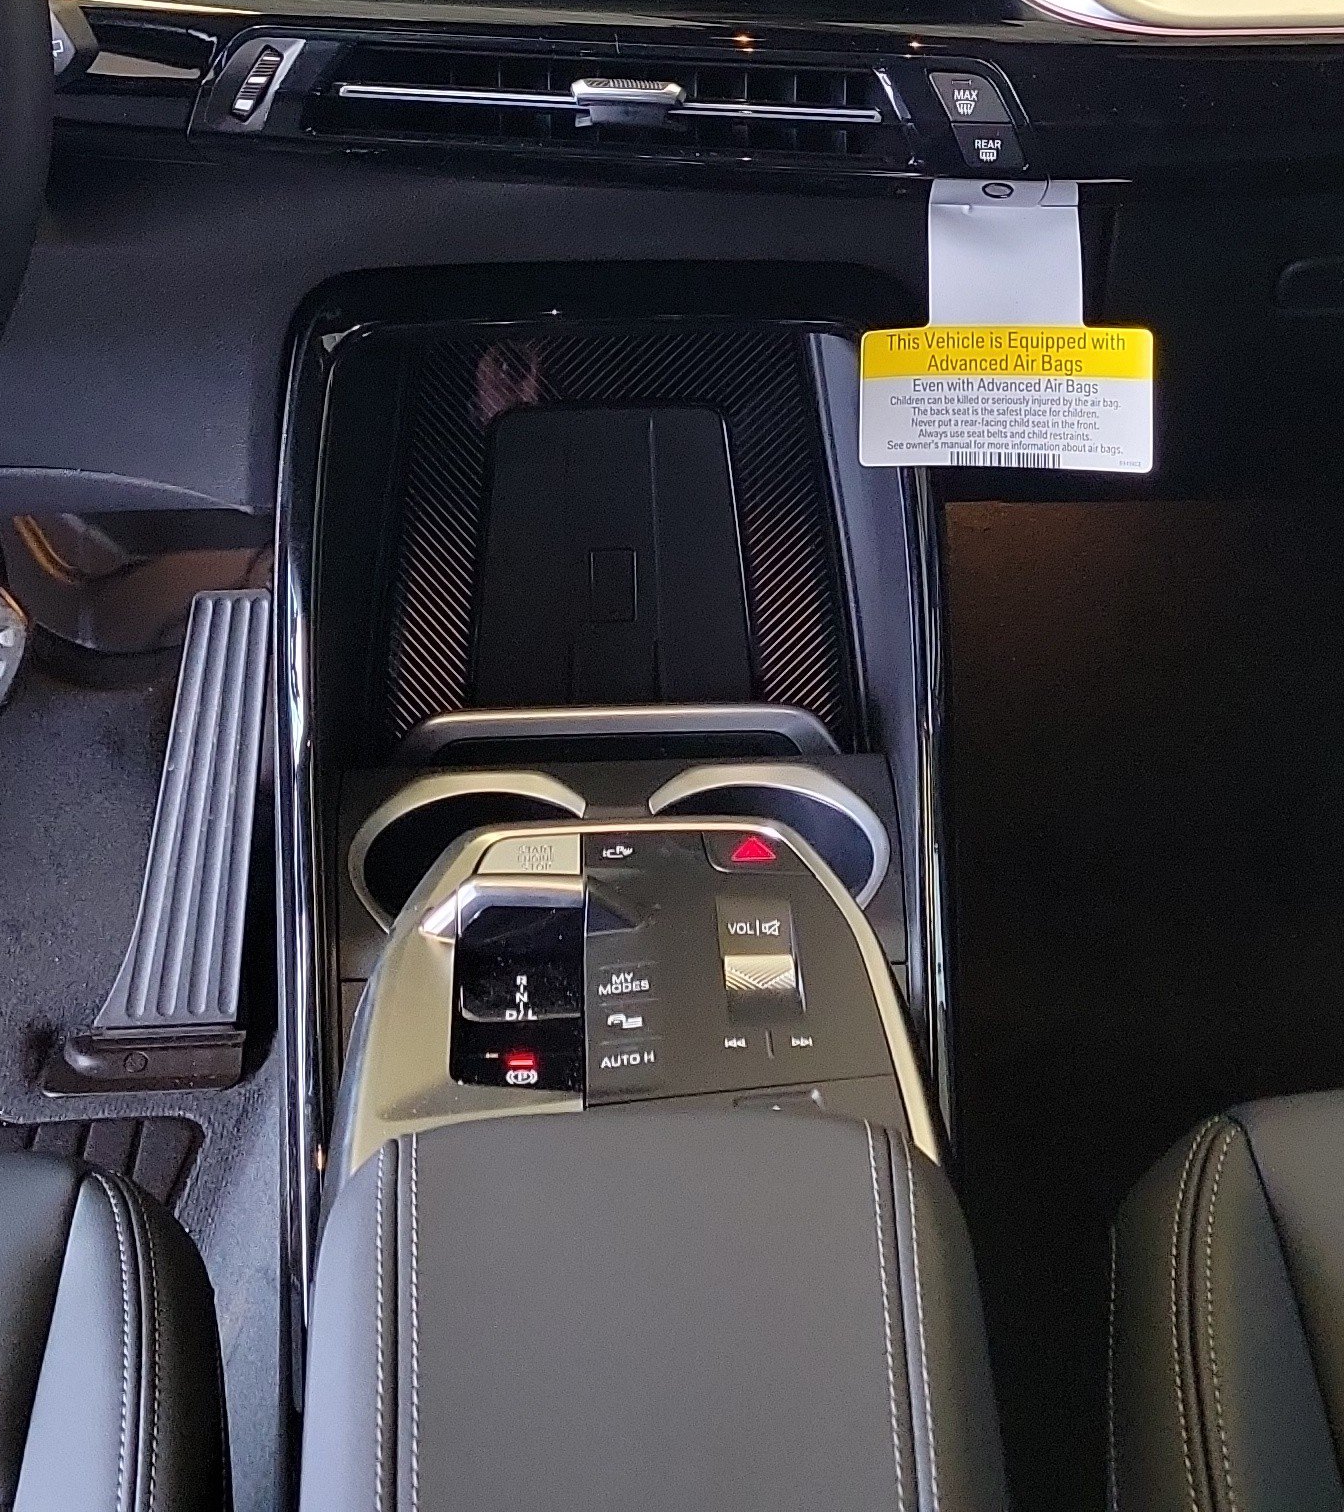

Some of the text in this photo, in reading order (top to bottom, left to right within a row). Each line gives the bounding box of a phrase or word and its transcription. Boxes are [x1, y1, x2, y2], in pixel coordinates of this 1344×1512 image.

[953, 89, 978, 101] MAX
[974, 140, 1001, 150] REAR
[886, 331, 1125, 353] This Vehicle is Equipped with
[927, 353, 1083, 376] Advanced Air Bags
[913, 378, 1099, 396] Even with Advanced Air Bags
[890, 395, 1121, 410] Children can be killed or seriously injured by the air bag.
[912, 406, 1099, 419] The back seat is the safest place for children.
[911, 418, 936, 427] Never
[938, 418, 952, 428] put
[961, 417, 1007, 429] rear-facing
[1009, 418, 1029, 428] child
[1032, 419, 1050, 428] seat
[1051, 418, 1059, 428] in
[1061, 419, 1075, 429] the
[1077, 420, 1100, 430] front.
[918, 428, 948, 440] Always
[967, 430, 985, 438] seat
[987, 429, 1007, 439] belts
[1009, 430, 1025, 439] and
[1027, 430, 1048, 440] child
[1049, 431, 1092, 441] restraints.
[887, 439, 1123, 456] See owner's manual for more information about air bags.
[727, 922, 754, 935] VOL
[516, 975, 527, 986] R
[612, 972, 633, 984] MY
[598, 980, 649, 996] MODES
[515, 991, 528, 1003] N
[600, 1051, 655, 1069] AUTO H
